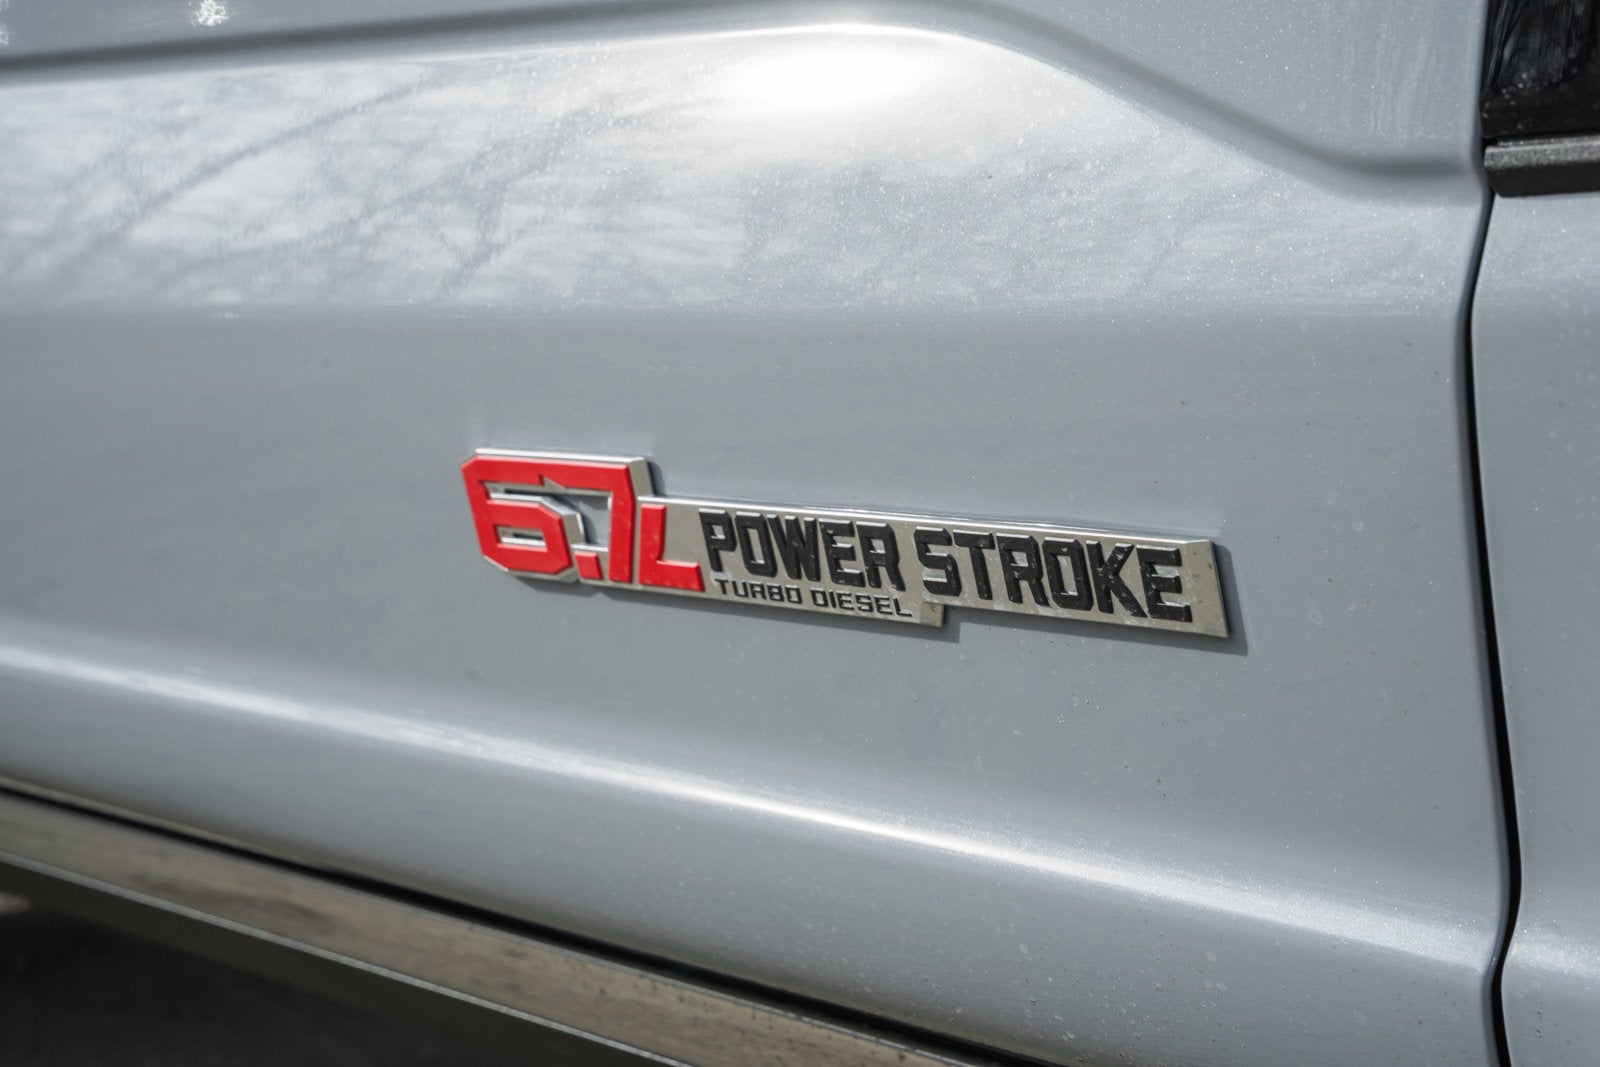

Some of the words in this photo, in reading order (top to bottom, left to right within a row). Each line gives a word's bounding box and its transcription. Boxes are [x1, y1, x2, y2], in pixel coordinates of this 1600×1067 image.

[461, 455, 705, 592] 6.7L
[699, 508, 906, 591] POWER
[914, 526, 1193, 623] STROKE
[715, 578, 802, 604] TURBO
[811, 587, 912, 617] DIESEL
